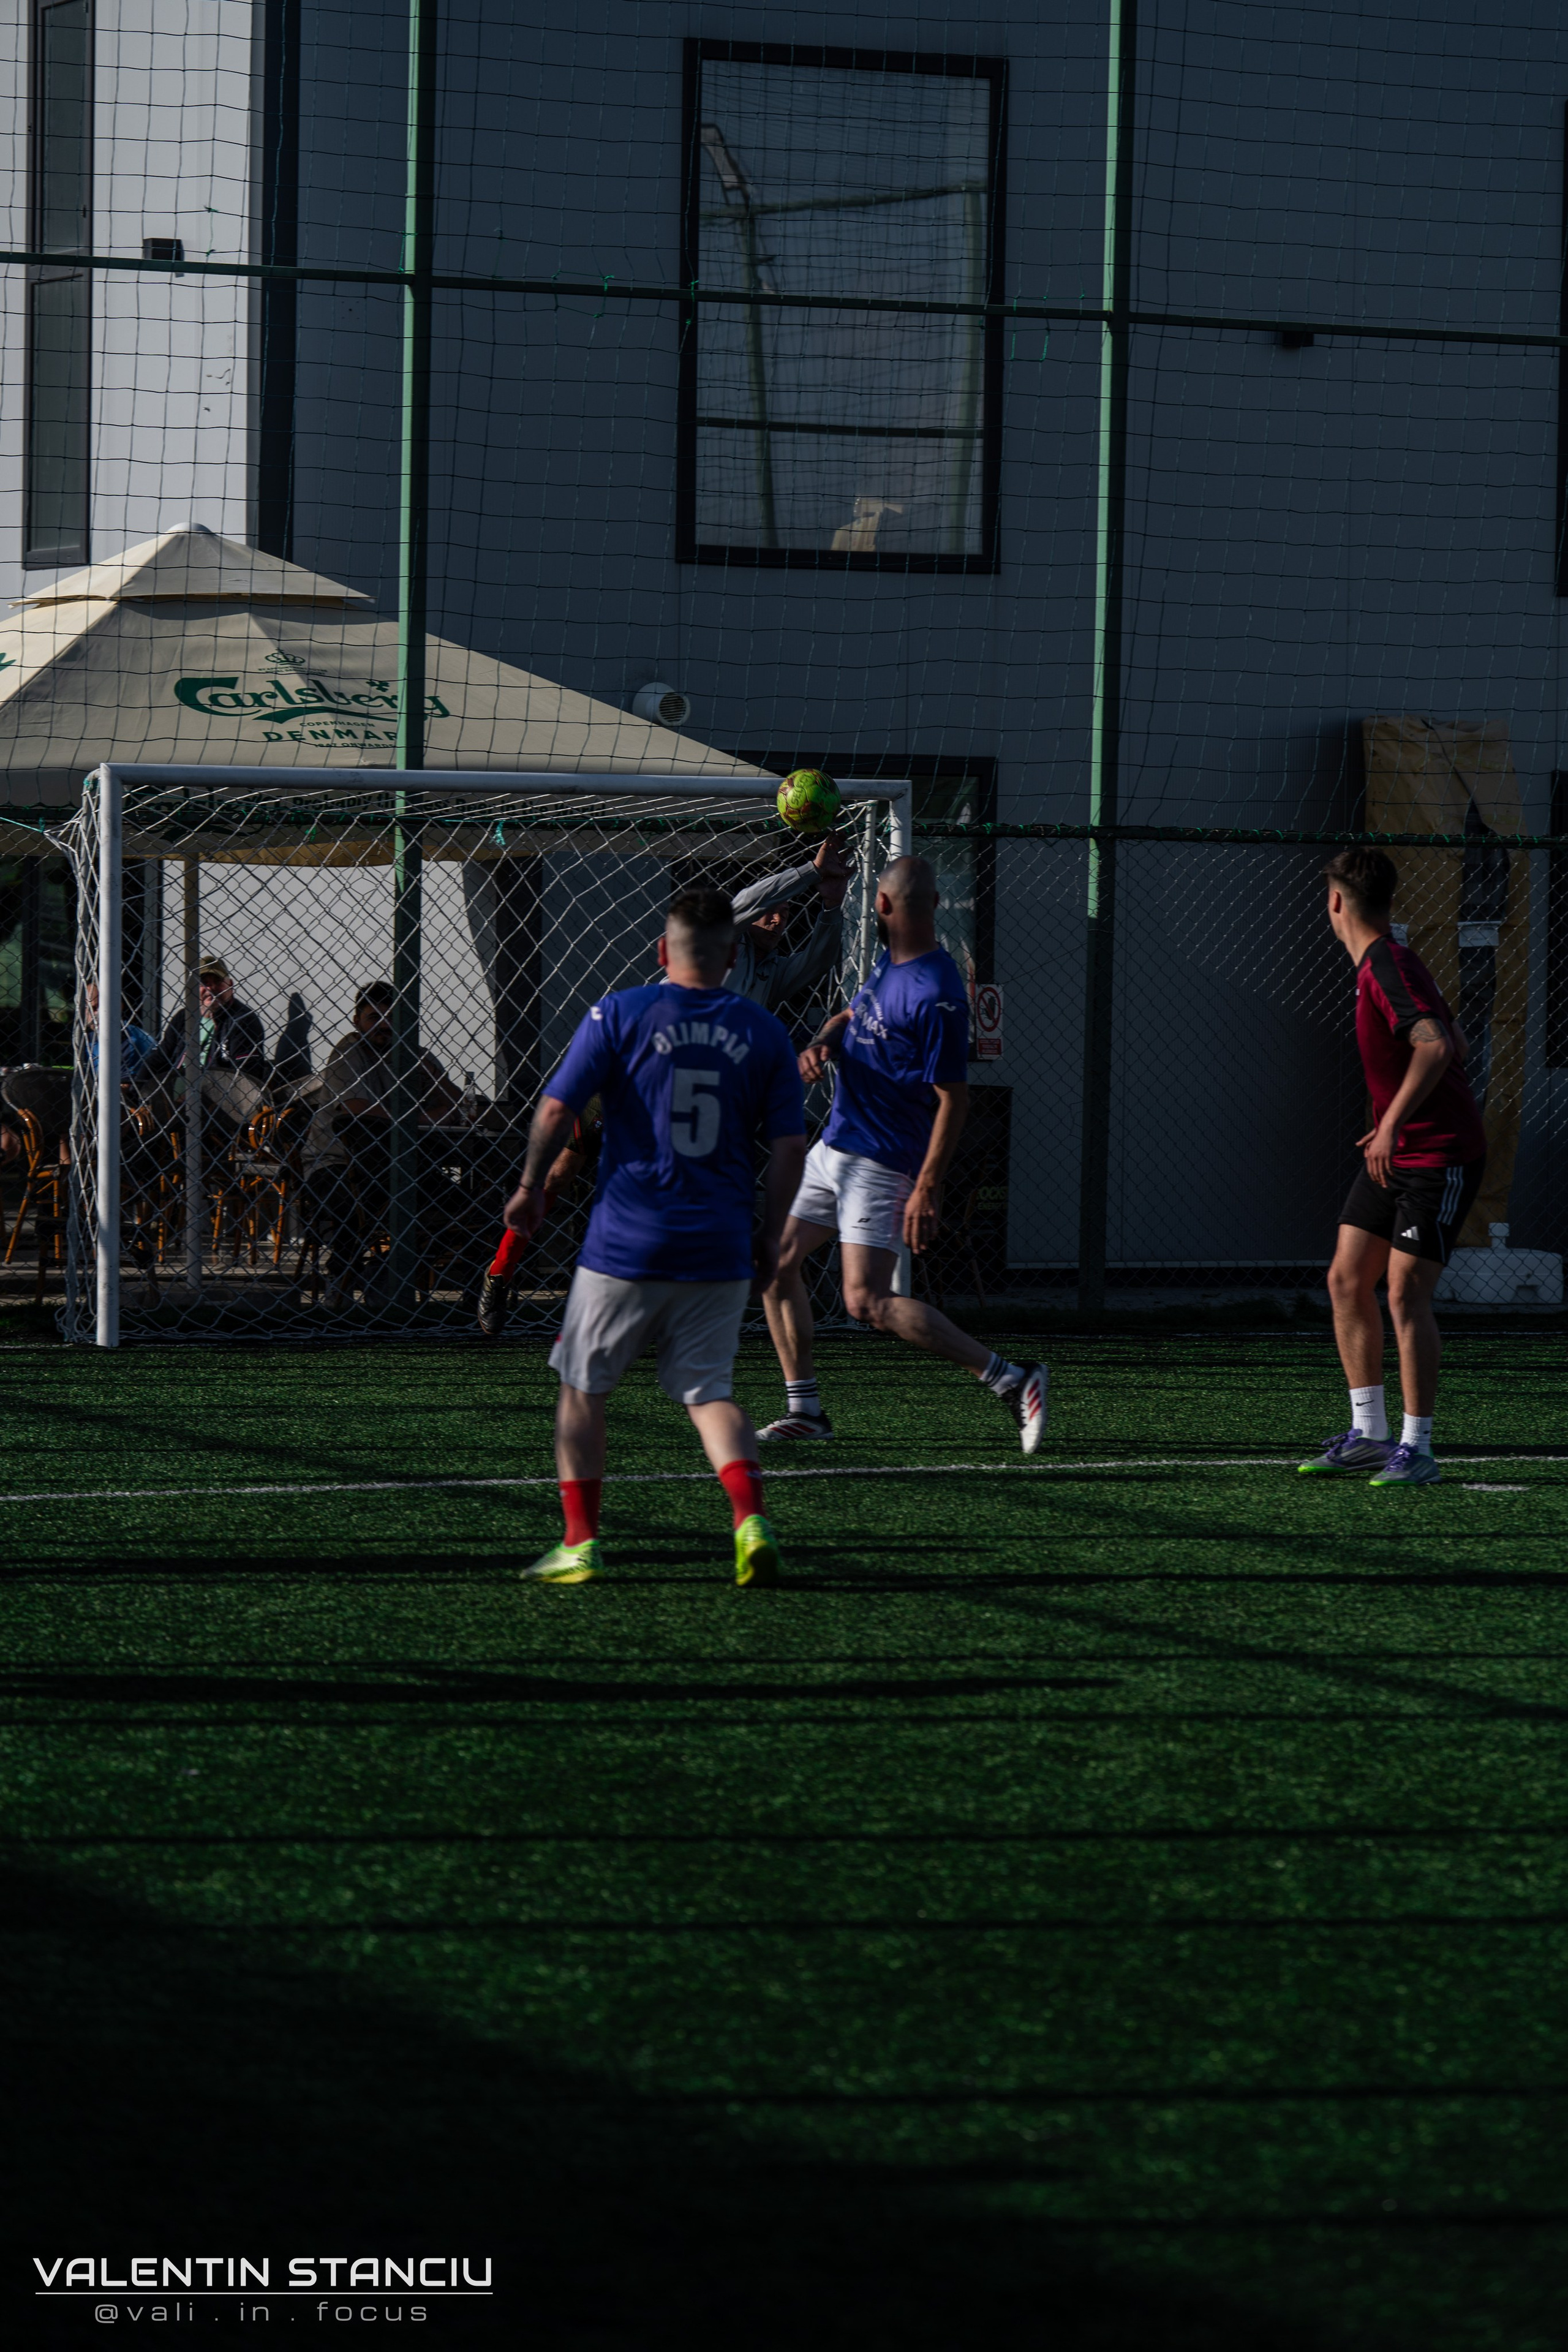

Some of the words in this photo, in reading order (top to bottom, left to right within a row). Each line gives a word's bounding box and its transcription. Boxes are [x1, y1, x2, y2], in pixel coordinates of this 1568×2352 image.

[262, 728, 428, 742] DENMAR
[652, 1021, 750, 1065] OLIMPIA
[671, 1067, 721, 1158] 5
